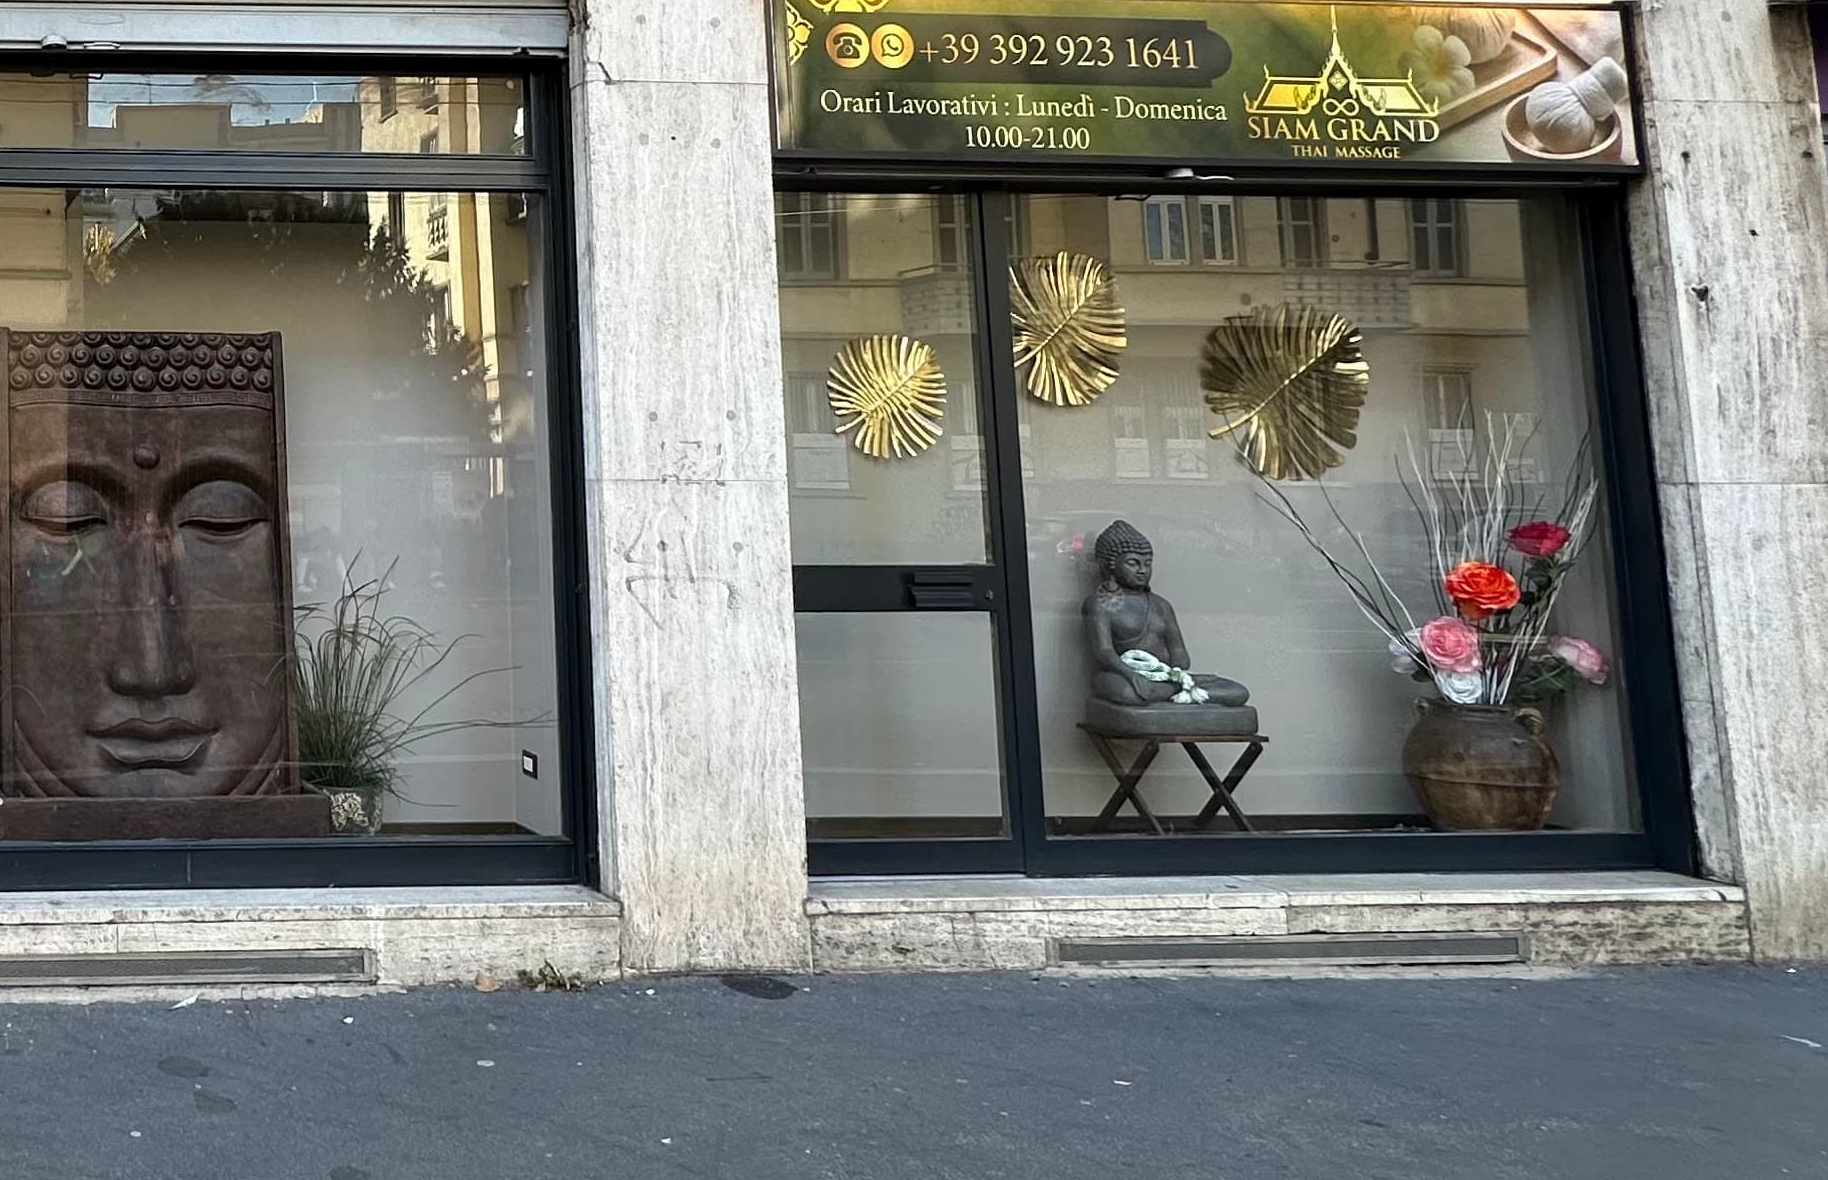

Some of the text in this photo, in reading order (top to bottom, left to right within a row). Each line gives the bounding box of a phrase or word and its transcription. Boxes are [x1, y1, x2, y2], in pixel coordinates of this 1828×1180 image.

[919, 33, 1198, 69] +39 392 923 1641
[820, 89, 882, 113] Orari
[887, 91, 998, 116] Lavorativi
[1015, 93, 1095, 118] Lunedì
[1113, 96, 1228, 121] Domenica
[965, 125, 1091, 150] 10.00-21.00
[1248, 116, 1440, 142] SIAM GRAND
[1291, 145, 1401, 159] THAI MASSAGE
